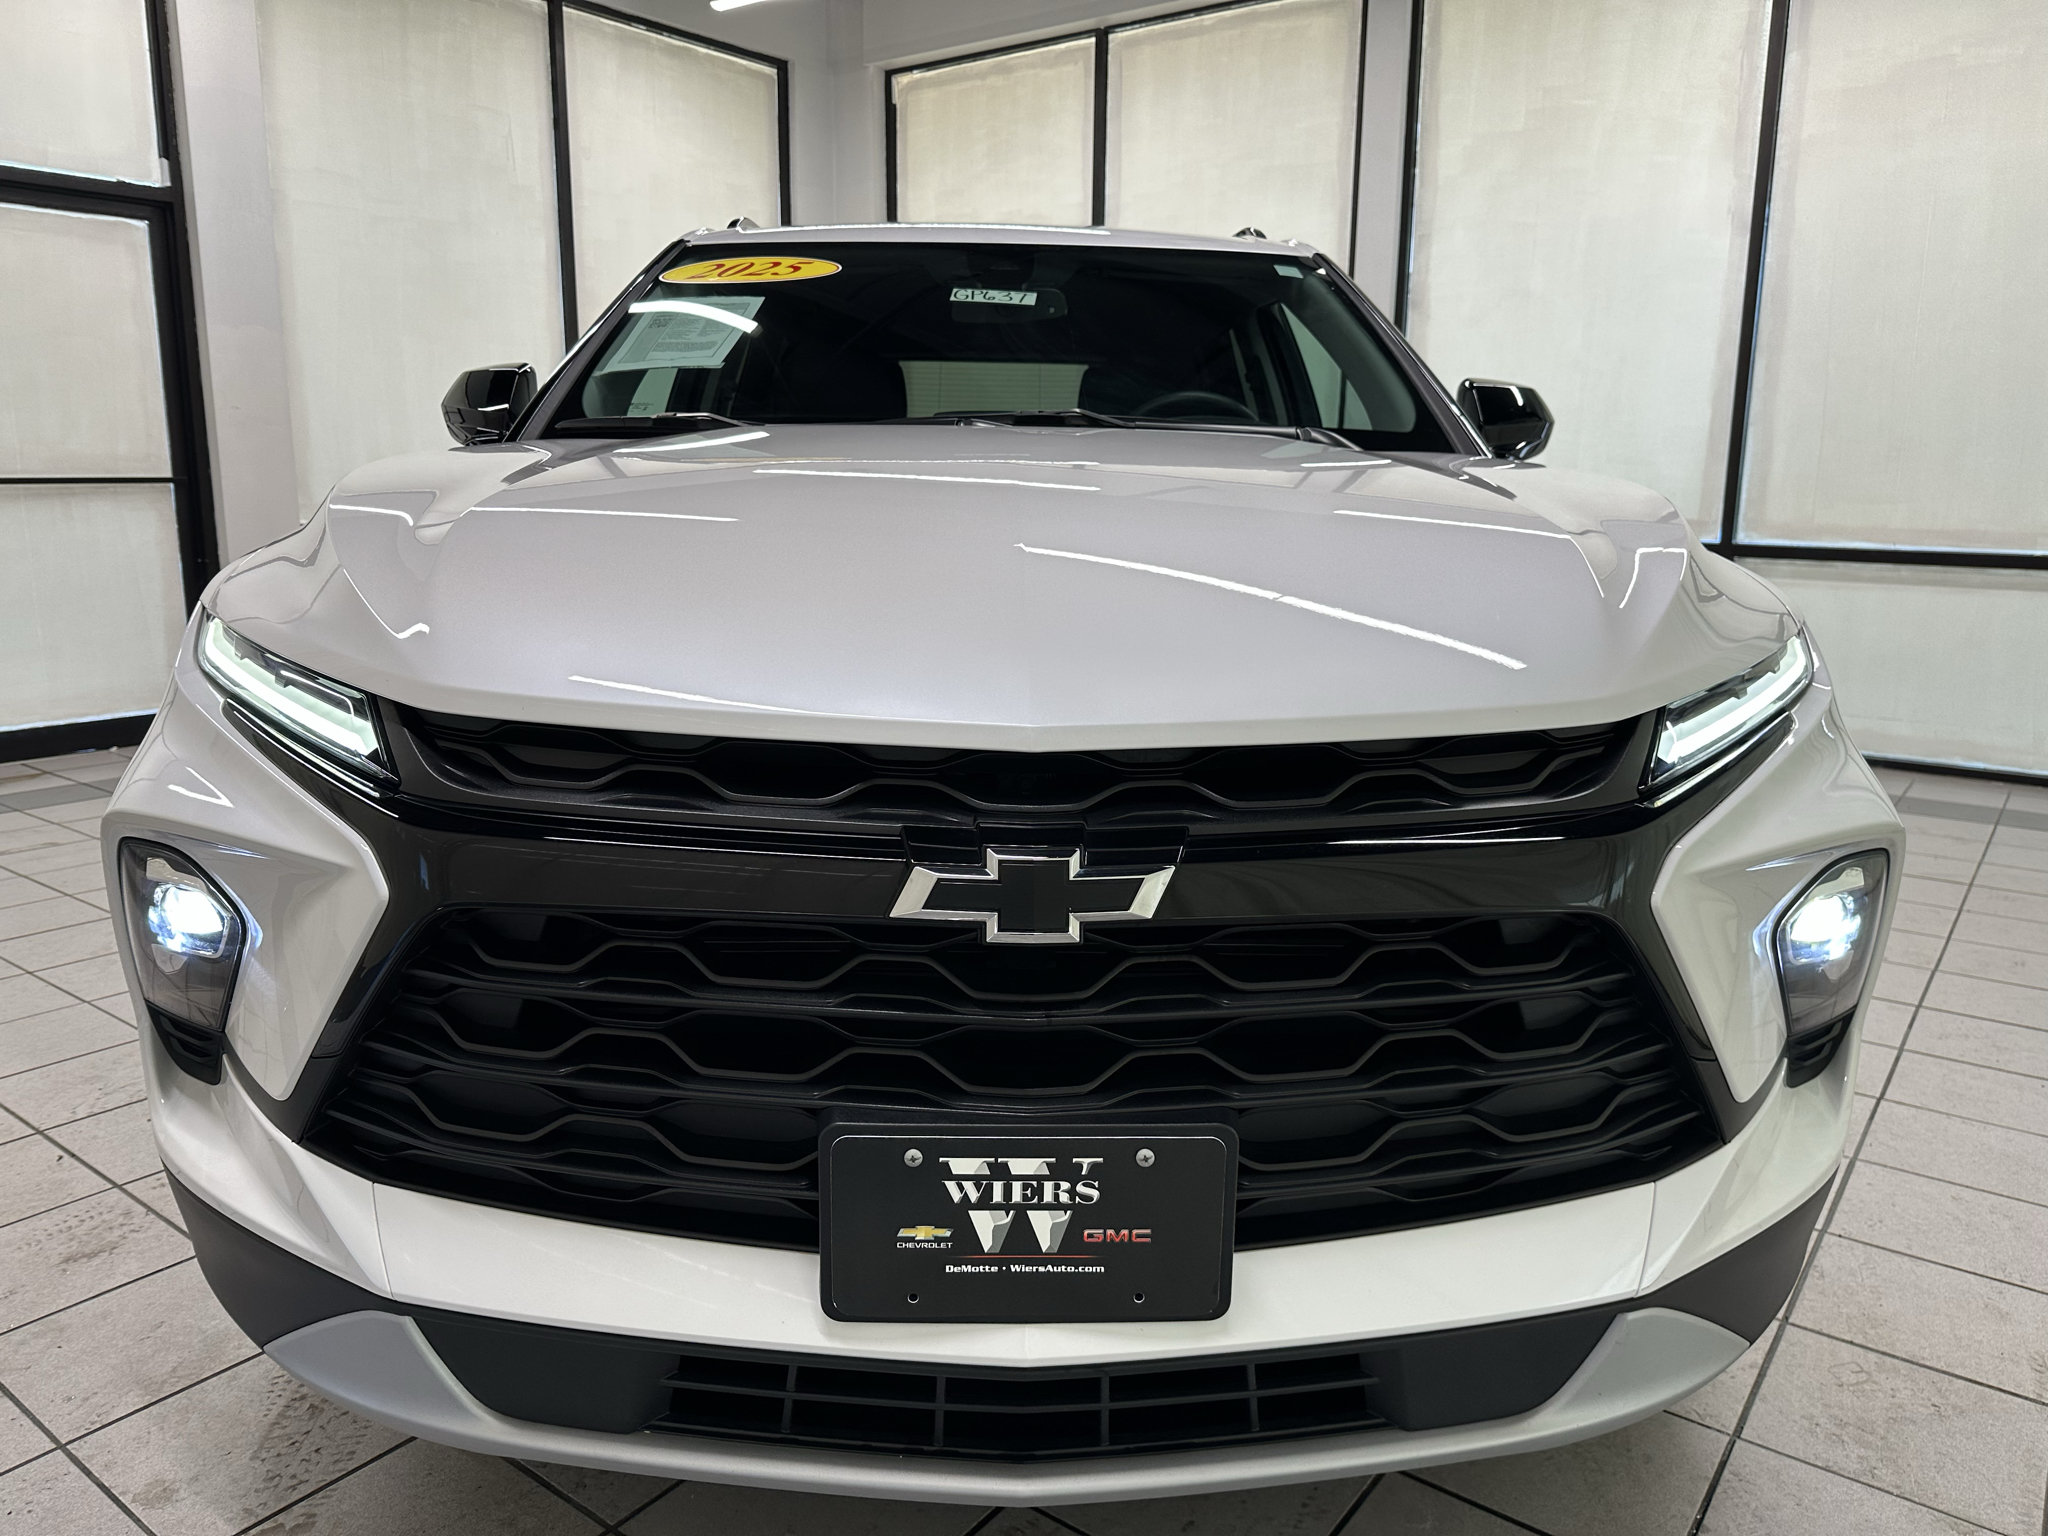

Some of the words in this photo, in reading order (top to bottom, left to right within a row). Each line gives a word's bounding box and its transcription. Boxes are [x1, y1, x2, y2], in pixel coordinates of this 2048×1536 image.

[683, 261, 815, 279] 2025
[953, 289, 1028, 303] GP637
[941, 1180, 1101, 1204] WIERS
[1083, 1229, 1152, 1243] GMC
[945, 1264, 999, 1273] DeMotte
[1010, 1264, 1105, 1273] WiersAuto.com
